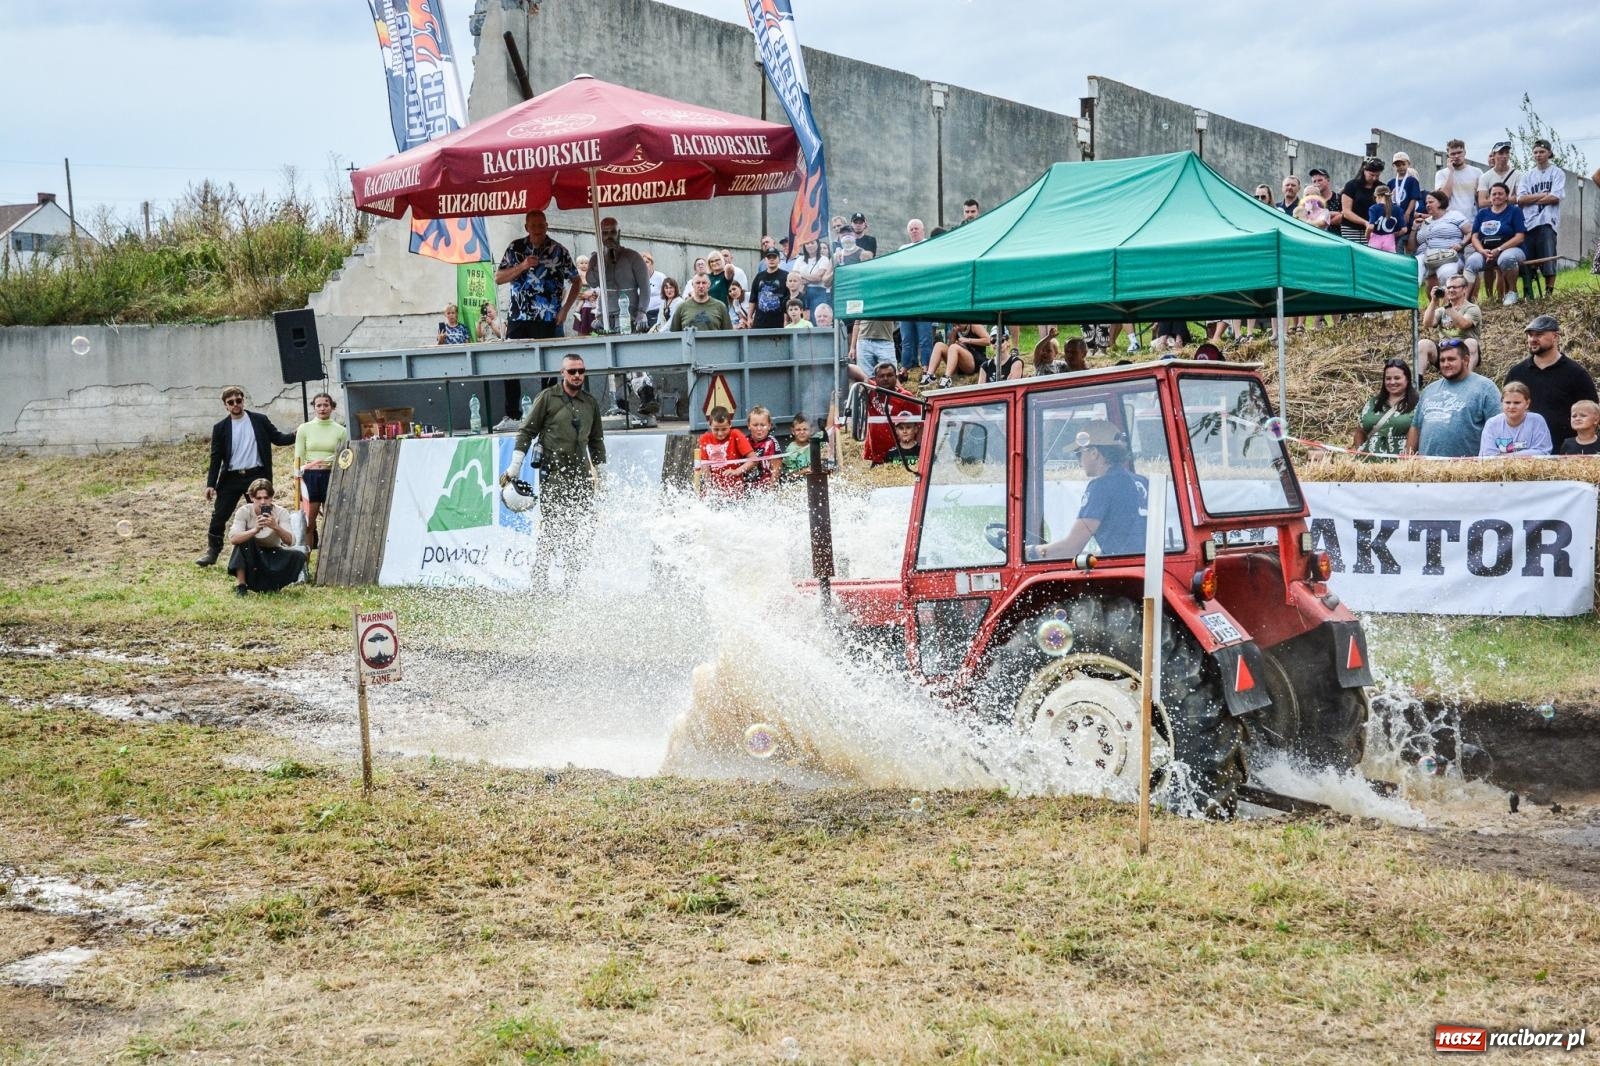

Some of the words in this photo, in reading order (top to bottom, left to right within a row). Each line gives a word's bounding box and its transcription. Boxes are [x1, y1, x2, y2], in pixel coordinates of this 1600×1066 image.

[482, 138, 601, 175] RACIBORSKIE
[670, 133, 771, 156] RACIBORSKIE
[364, 163, 421, 198] RACIBORSKIE
[1310, 517, 1573, 577] AKTOR
[361, 611, 393, 623] WARNING
[371, 674, 391, 684] ZONE
